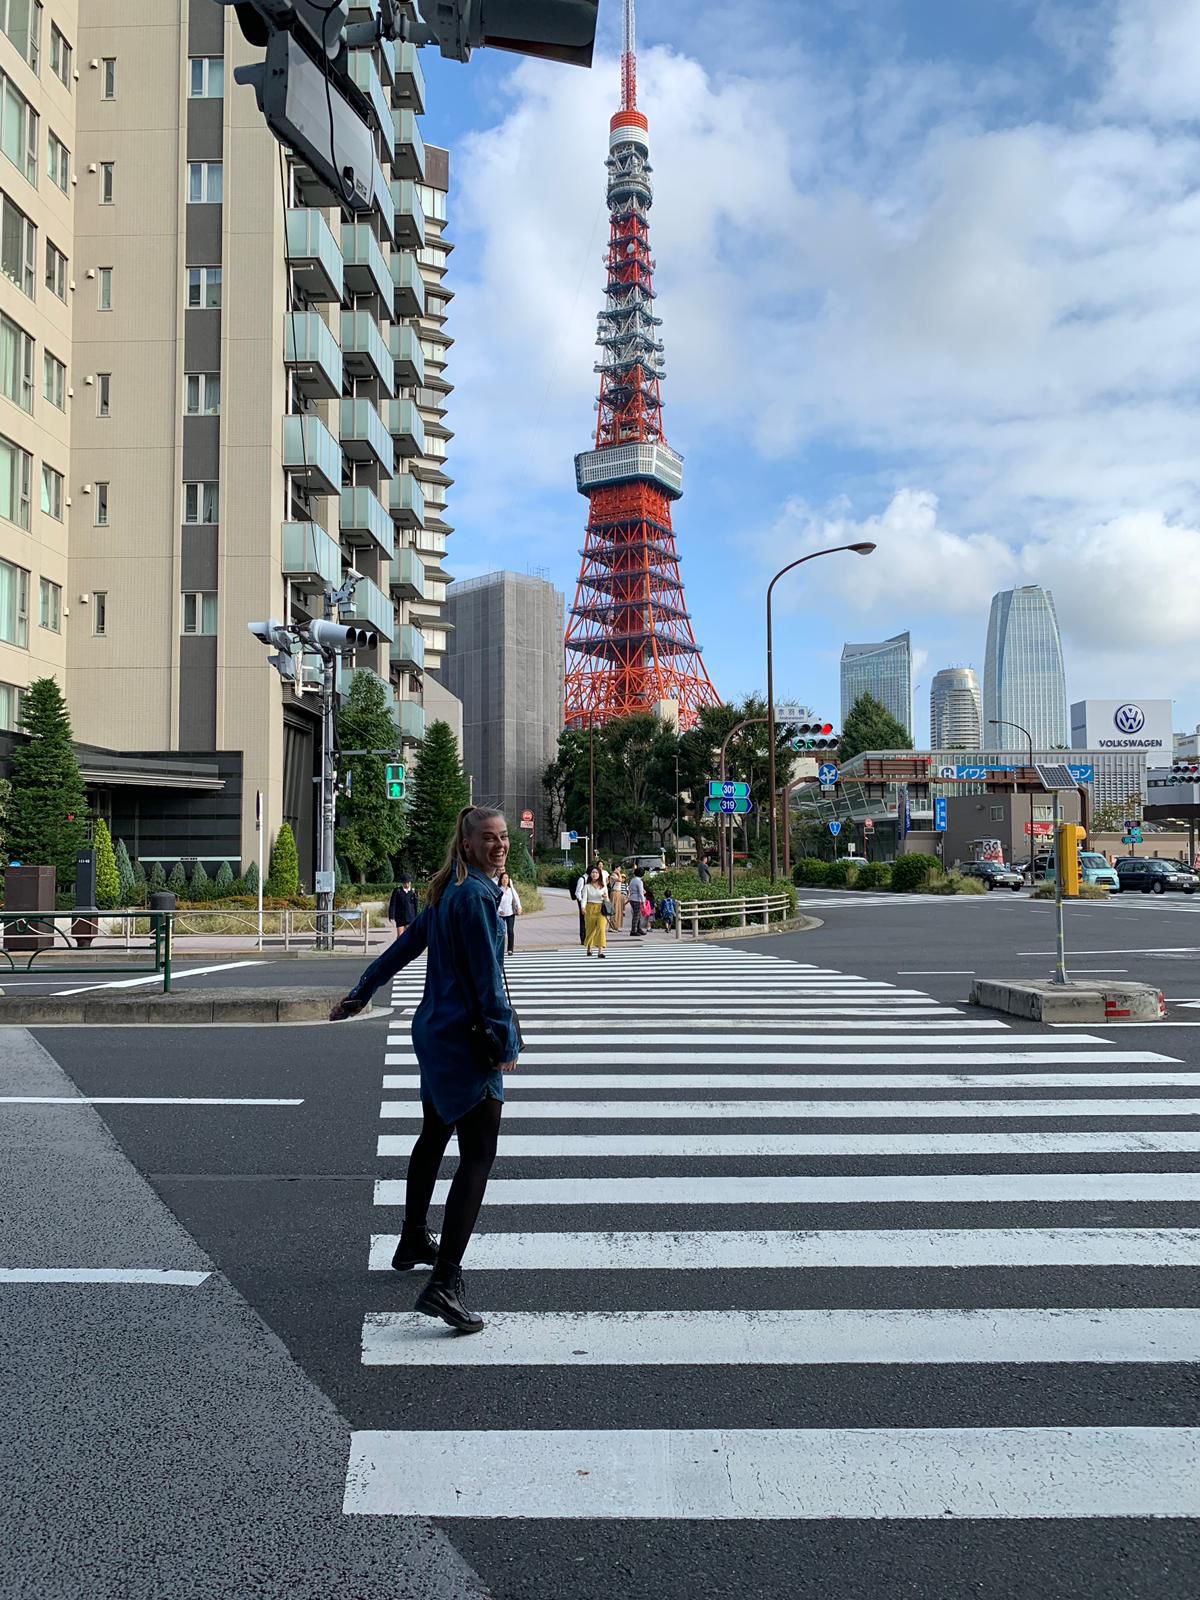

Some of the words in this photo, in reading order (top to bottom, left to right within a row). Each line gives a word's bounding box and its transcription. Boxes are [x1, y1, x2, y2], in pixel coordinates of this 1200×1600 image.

[1099, 739, 1163, 748] VOLKSWAGEN
[723, 785, 735, 794] 301
[721, 800, 735, 810] 319
